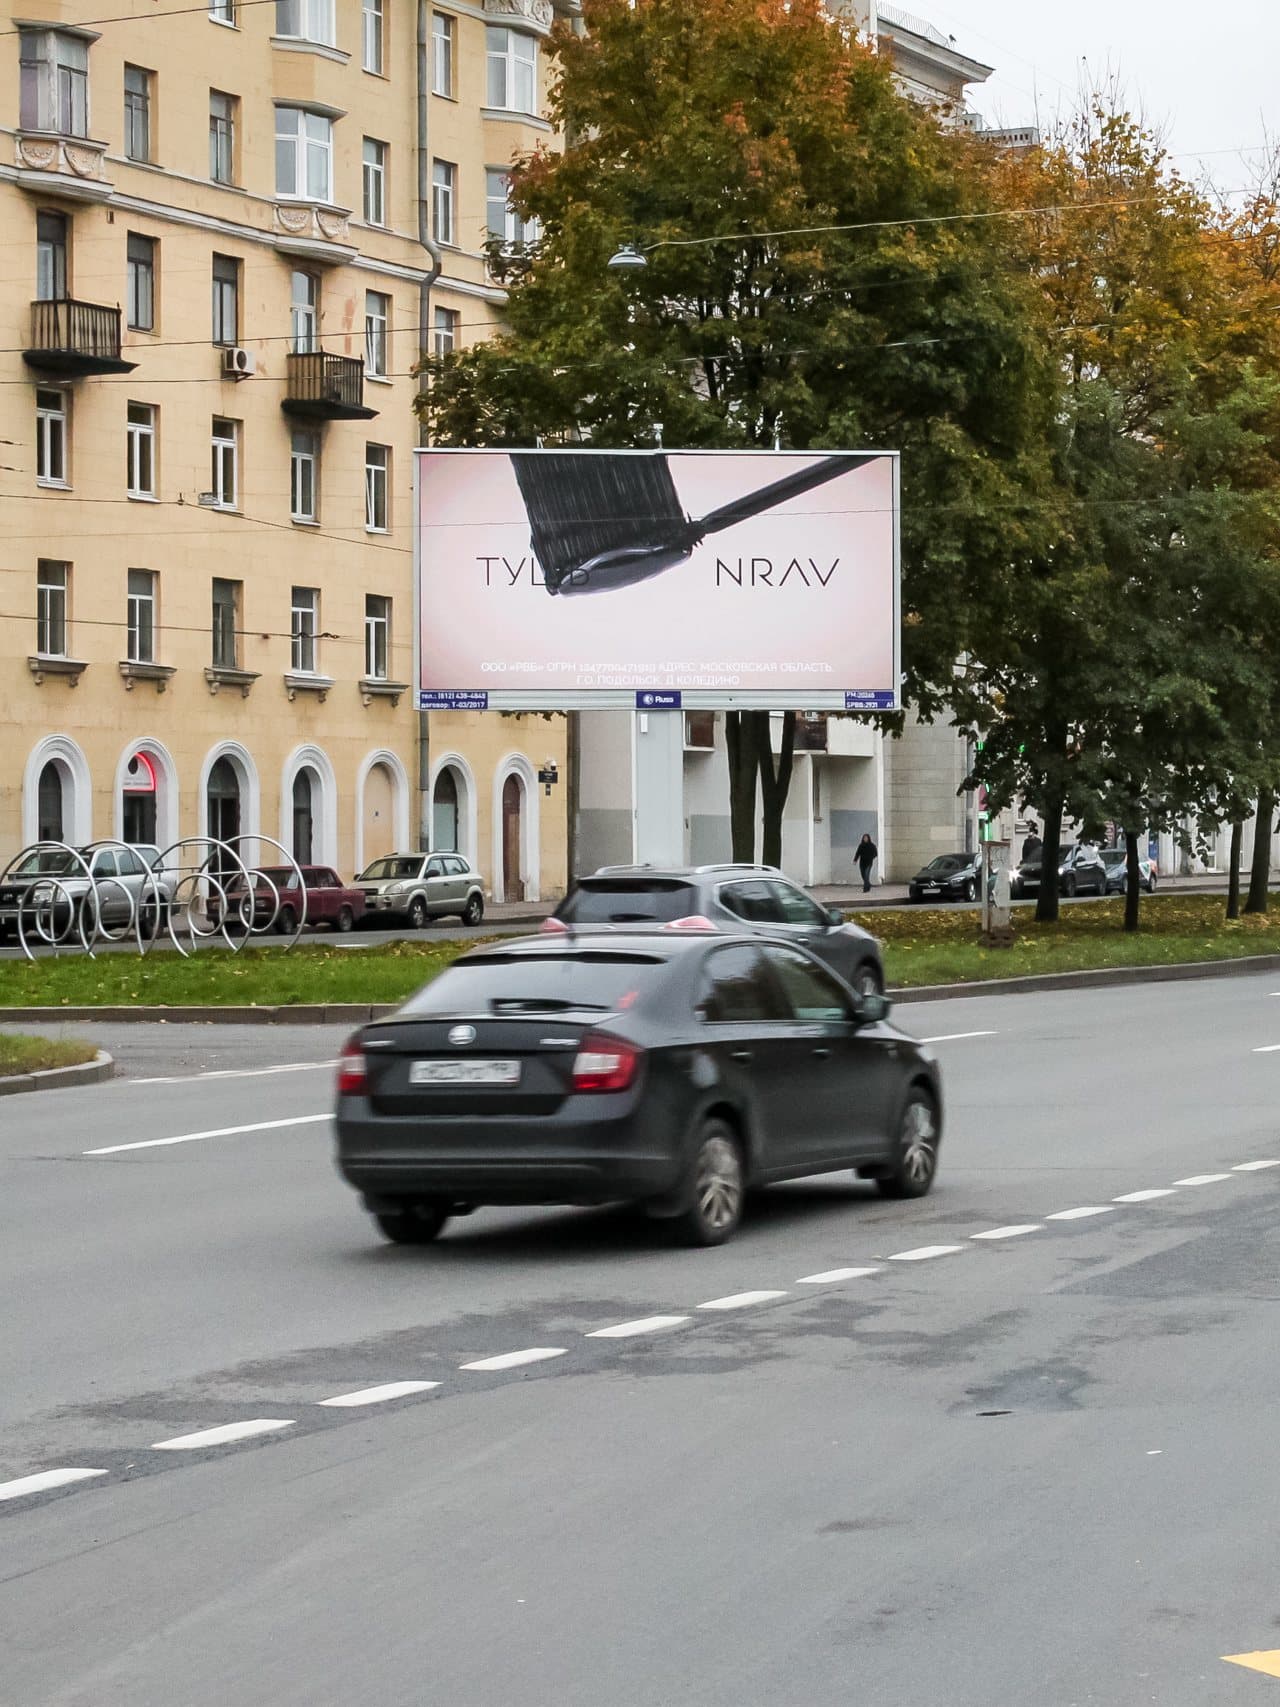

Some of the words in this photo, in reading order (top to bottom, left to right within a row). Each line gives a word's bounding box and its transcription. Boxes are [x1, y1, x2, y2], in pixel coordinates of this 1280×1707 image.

[716, 557, 840, 587] NRAV
[481, 662, 507, 673] ООО
[546, 662, 576, 673] ОГРН
[700, 661, 777, 673] МОСКОВСКАЯ
[676, 674, 740, 687] КОЛЕДИНО
[655, 695, 674, 703] Russ
